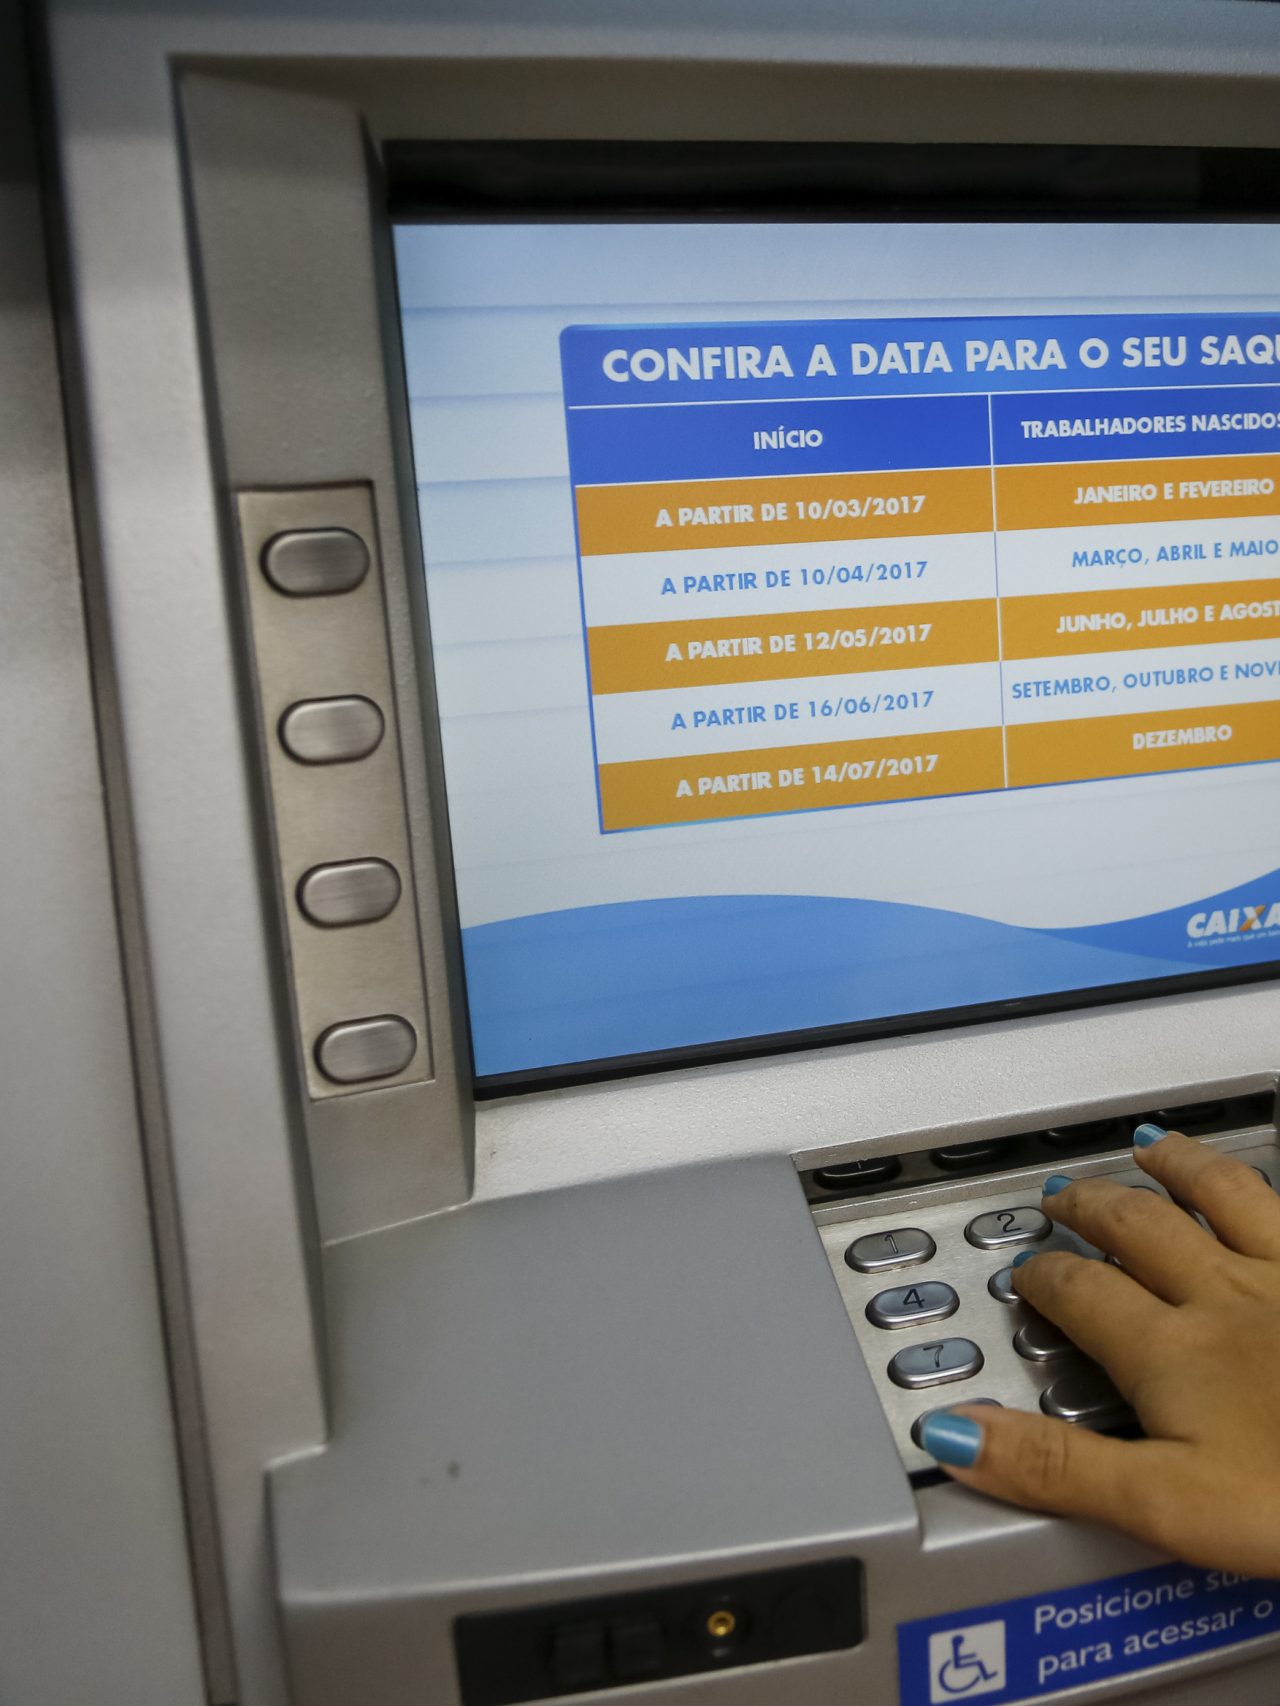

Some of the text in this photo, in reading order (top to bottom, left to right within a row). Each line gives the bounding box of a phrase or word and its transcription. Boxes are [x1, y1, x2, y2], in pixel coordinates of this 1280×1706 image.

[603, 344, 793, 382] CONFIRA
[806, 344, 837, 376] A
[852, 340, 952, 375] DATA
[966, 338, 1067, 371] PARA
[1079, 337, 1109, 368] O
[1122, 335, 1186, 368] SEU
[754, 425, 823, 450] INÍCIO
[1021, 416, 1186, 439] TRABALHADORES
[1074, 478, 1274, 505] JANEIRO E FEVEREIRO
[656, 495, 926, 528] A PARTIR DE 10/03/2017
[1072, 539, 1280, 568] MARÇO, ABRIL E MAIO
[661, 560, 928, 595] A PARTIR DE 10/04/2017
[1056, 612, 1133, 633] JUNHO,
[1137, 606, 1199, 628] JULHO
[1205, 605, 1214, 622] E
[665, 624, 932, 661] A PARTIR DE 12/05/2017
[1012, 676, 1116, 699] SETEMBRO,
[1123, 667, 1214, 690] OUTUBRO
[1220, 664, 1229, 682] E
[671, 690, 934, 731] A PARTIR DE 16/06/2017
[1133, 724, 1233, 750] DEZEMBRO
[676, 754, 938, 798] A PARTIR DE 14/07/2017
[997, 1213, 1022, 1232] 2
[884, 1234, 899, 1253] 1
[902, 1288, 926, 1309] 4
[923, 1345, 942, 1368] 7
[1034, 1578, 1195, 1635] Posicione
[1038, 1641, 1113, 1685] para
[1123, 1606, 1244, 1656] acessar
[1253, 1599, 1274, 1619] o
